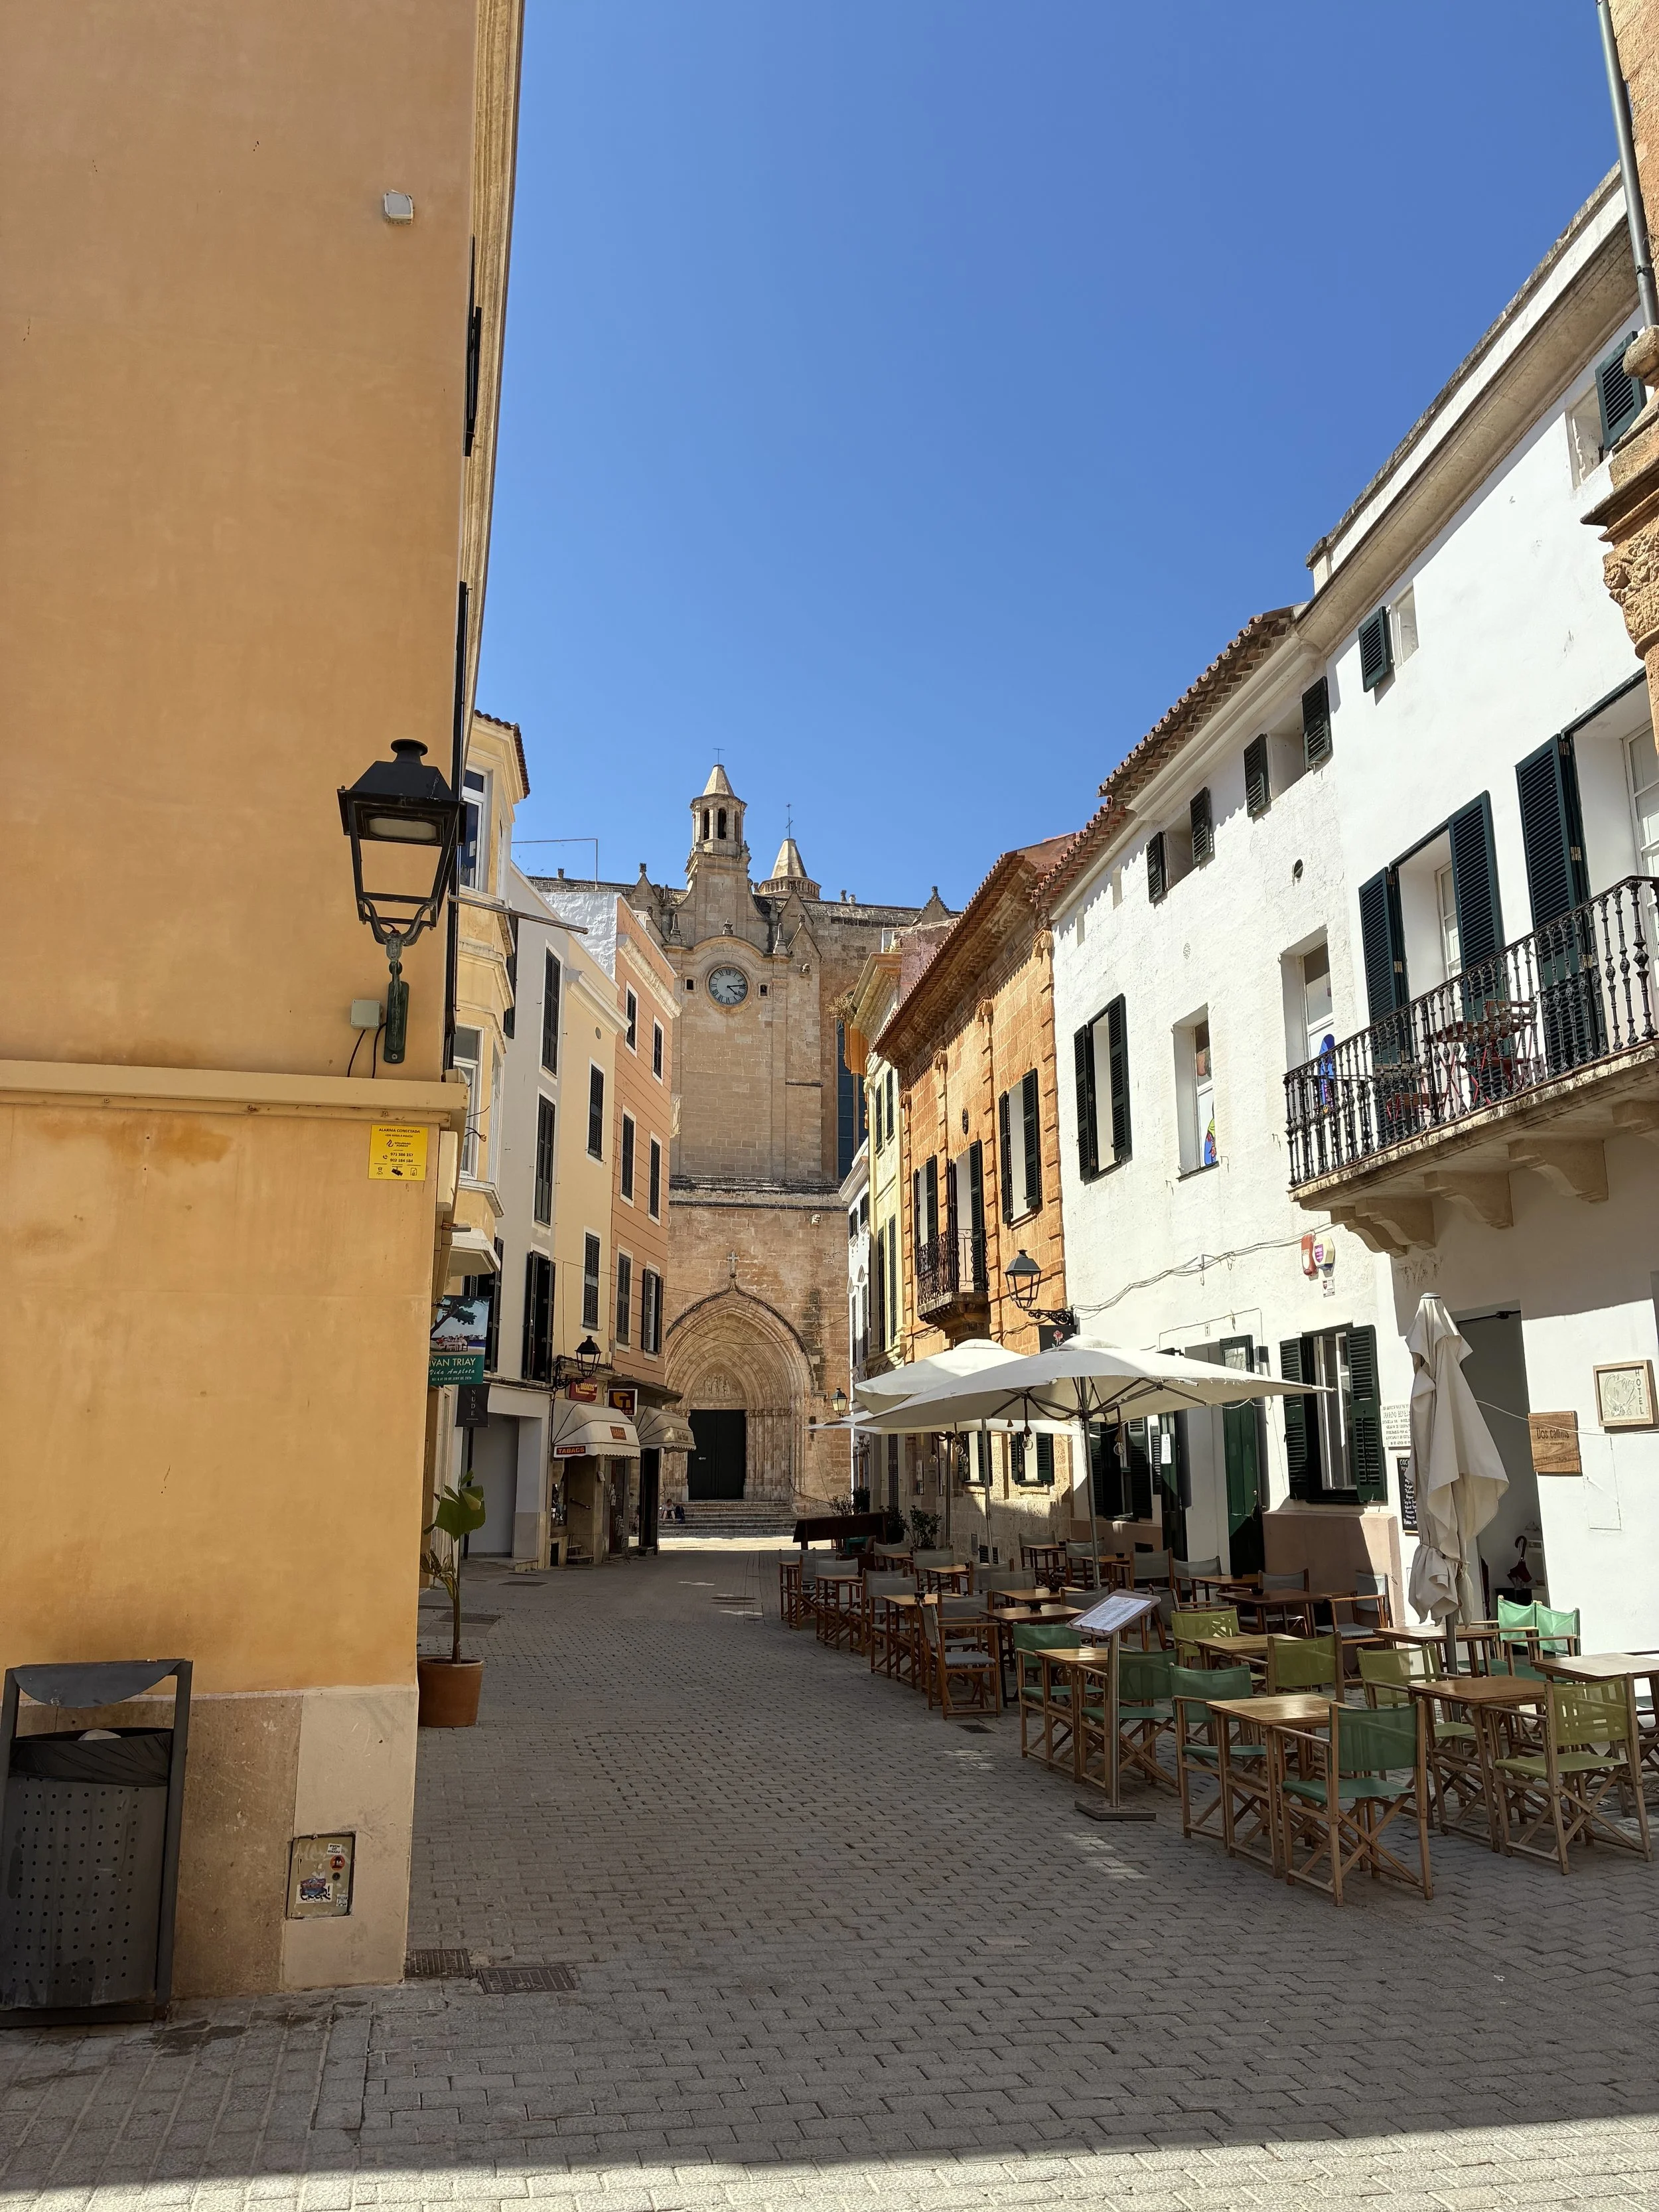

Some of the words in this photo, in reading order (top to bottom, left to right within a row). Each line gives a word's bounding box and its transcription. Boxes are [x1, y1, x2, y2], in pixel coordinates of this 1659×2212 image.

[453, 1358, 476, 1366] TRIAY
[1635, 1369, 1644, 1414] HOTEL
[1536, 1428, 1548, 1439] Dos
